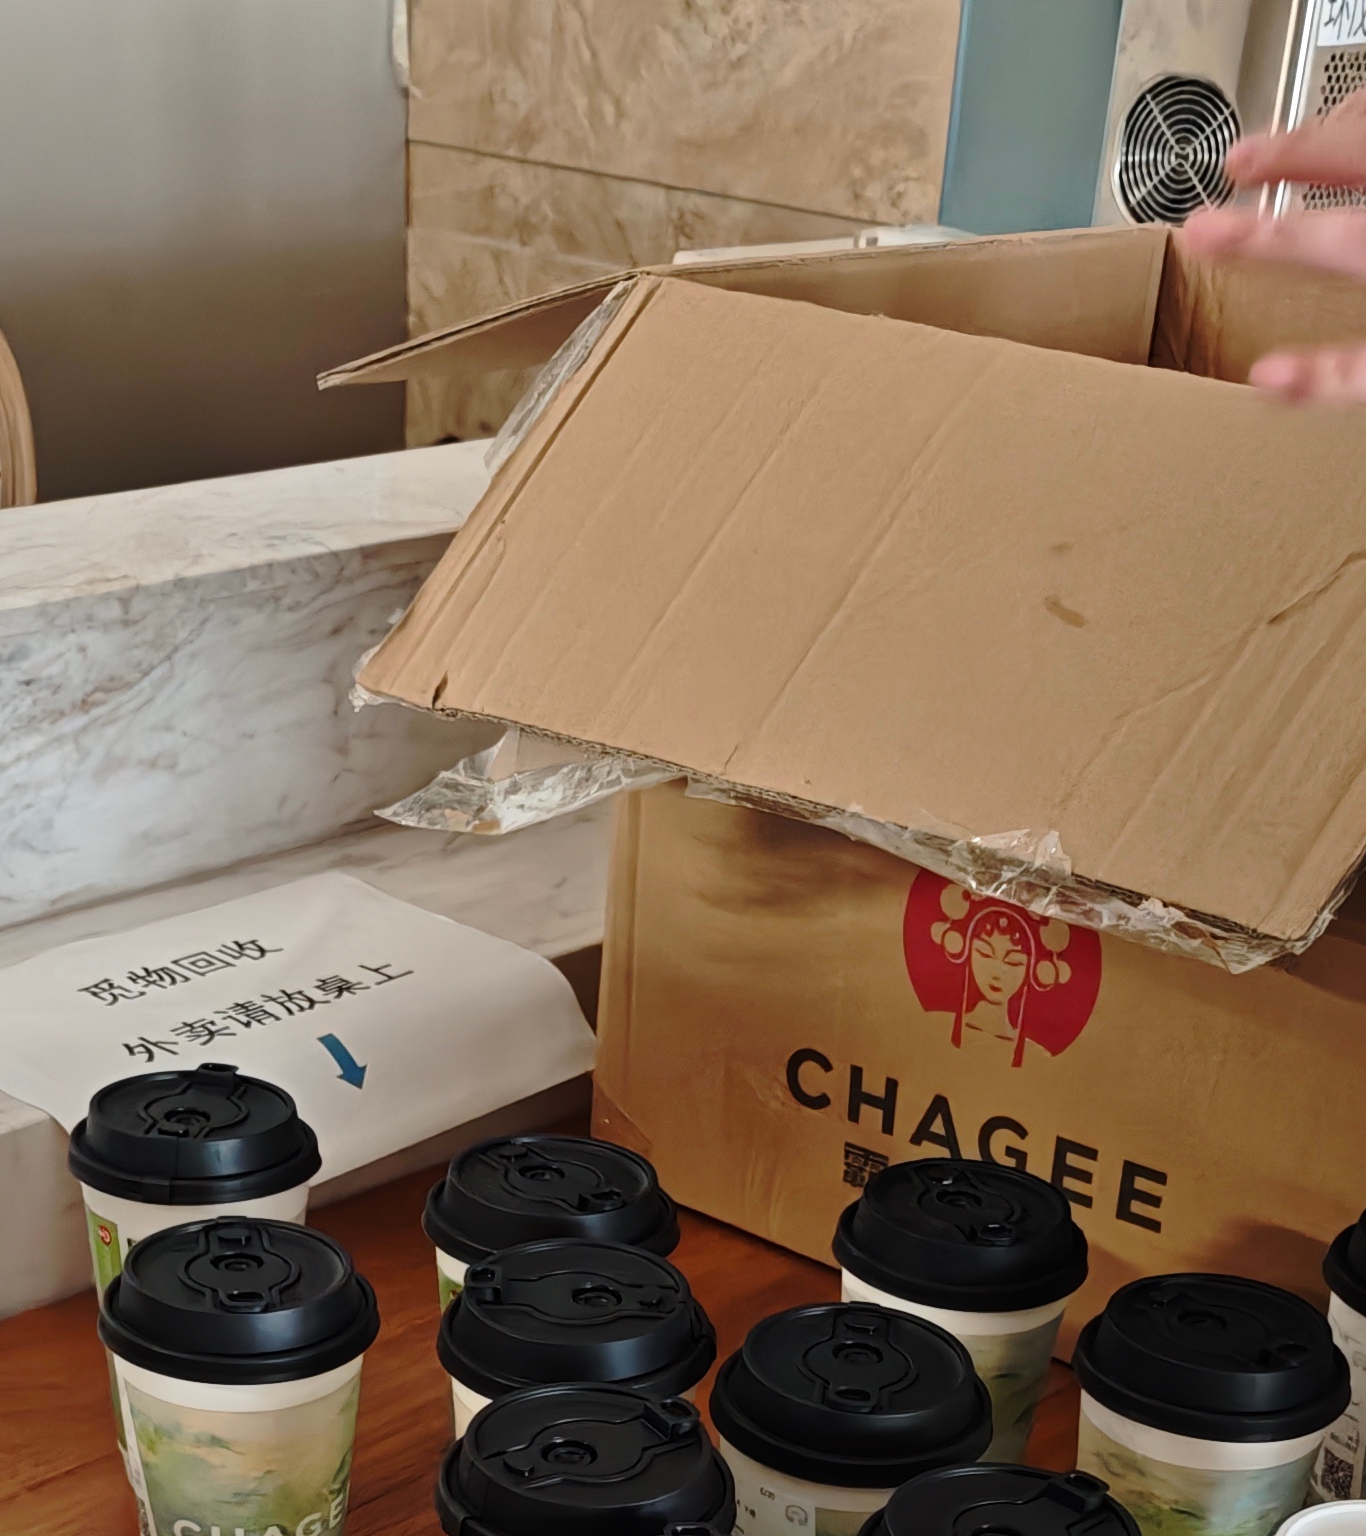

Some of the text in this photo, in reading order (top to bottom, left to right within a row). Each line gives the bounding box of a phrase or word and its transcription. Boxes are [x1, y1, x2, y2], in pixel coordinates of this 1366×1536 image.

[77, 938, 284, 1006] 觅物回收
[122, 960, 415, 1063] 外卖请放桌上
[785, 1047, 1169, 1235] CHAGEE
